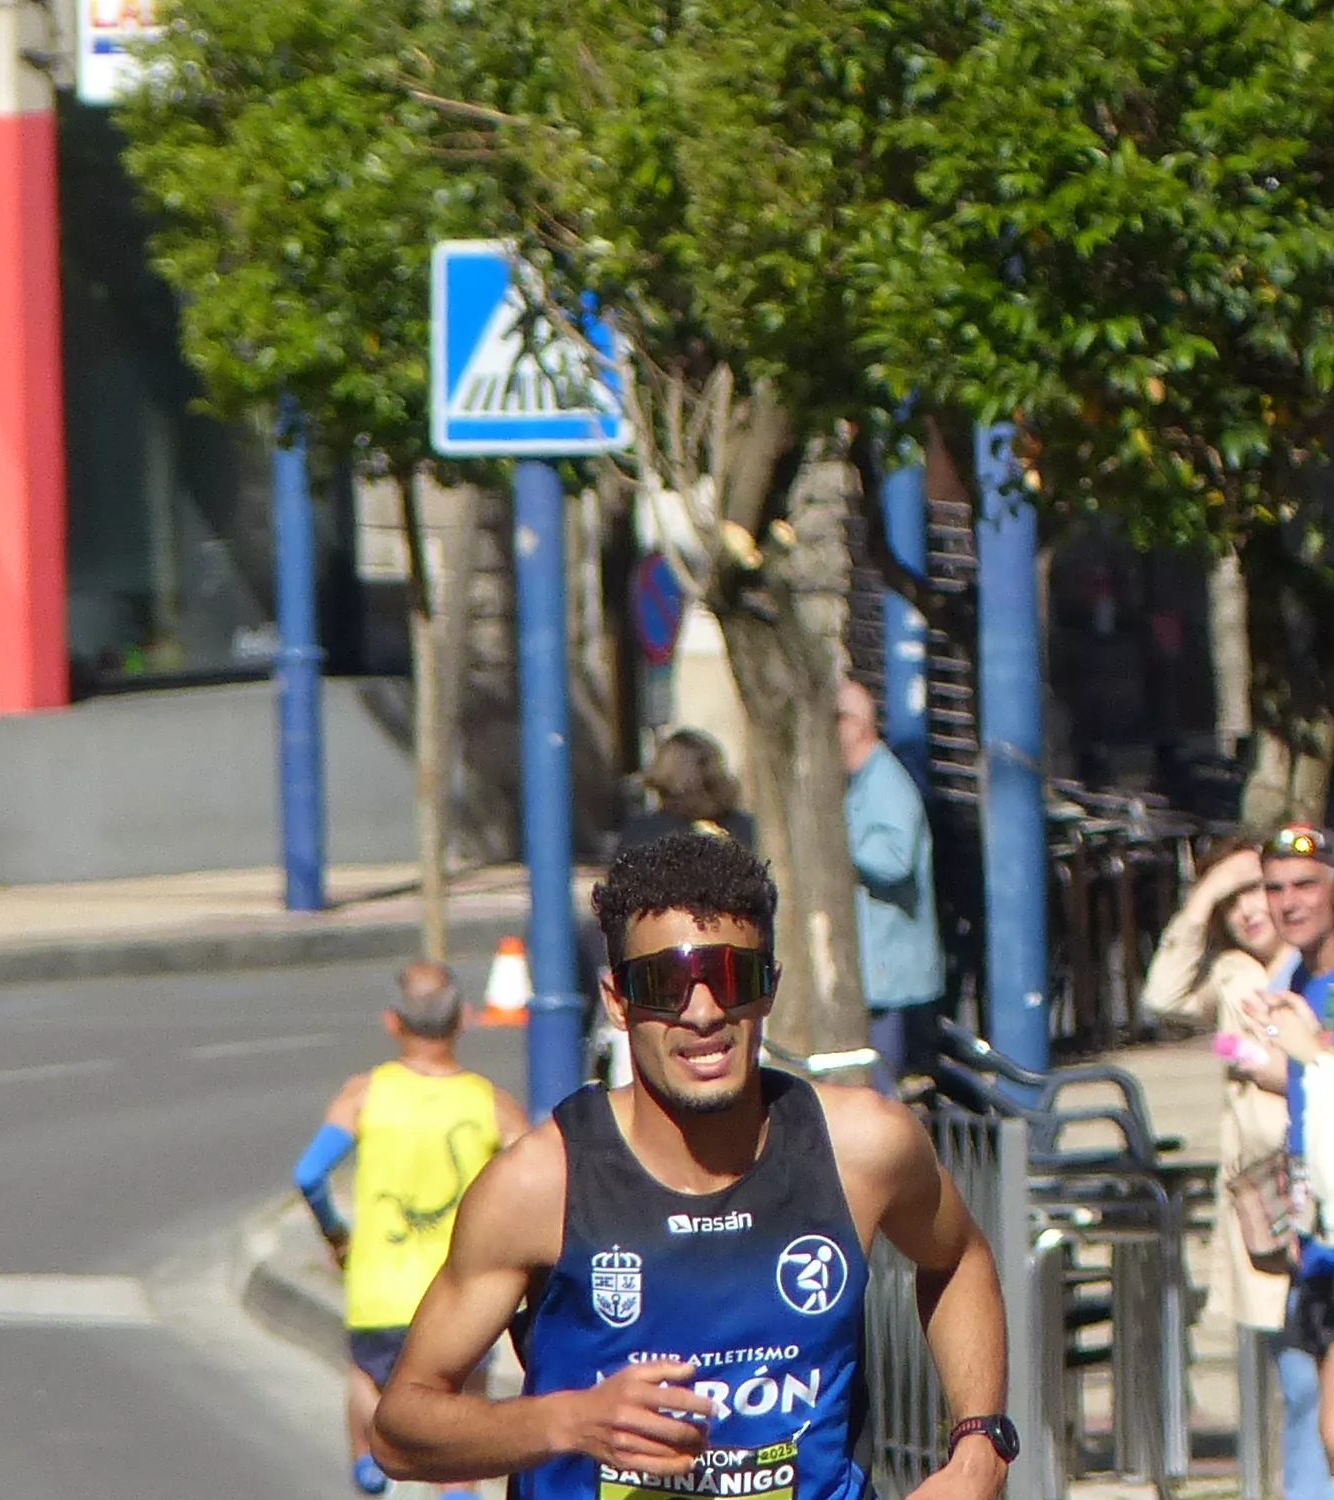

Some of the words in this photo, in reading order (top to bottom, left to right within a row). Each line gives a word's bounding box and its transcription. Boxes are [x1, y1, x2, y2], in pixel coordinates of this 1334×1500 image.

[687, 1345, 799, 1367] ATLETISMO
[596, 1365, 820, 1421] RÓN
[761, 1443, 793, 1461] 2025
